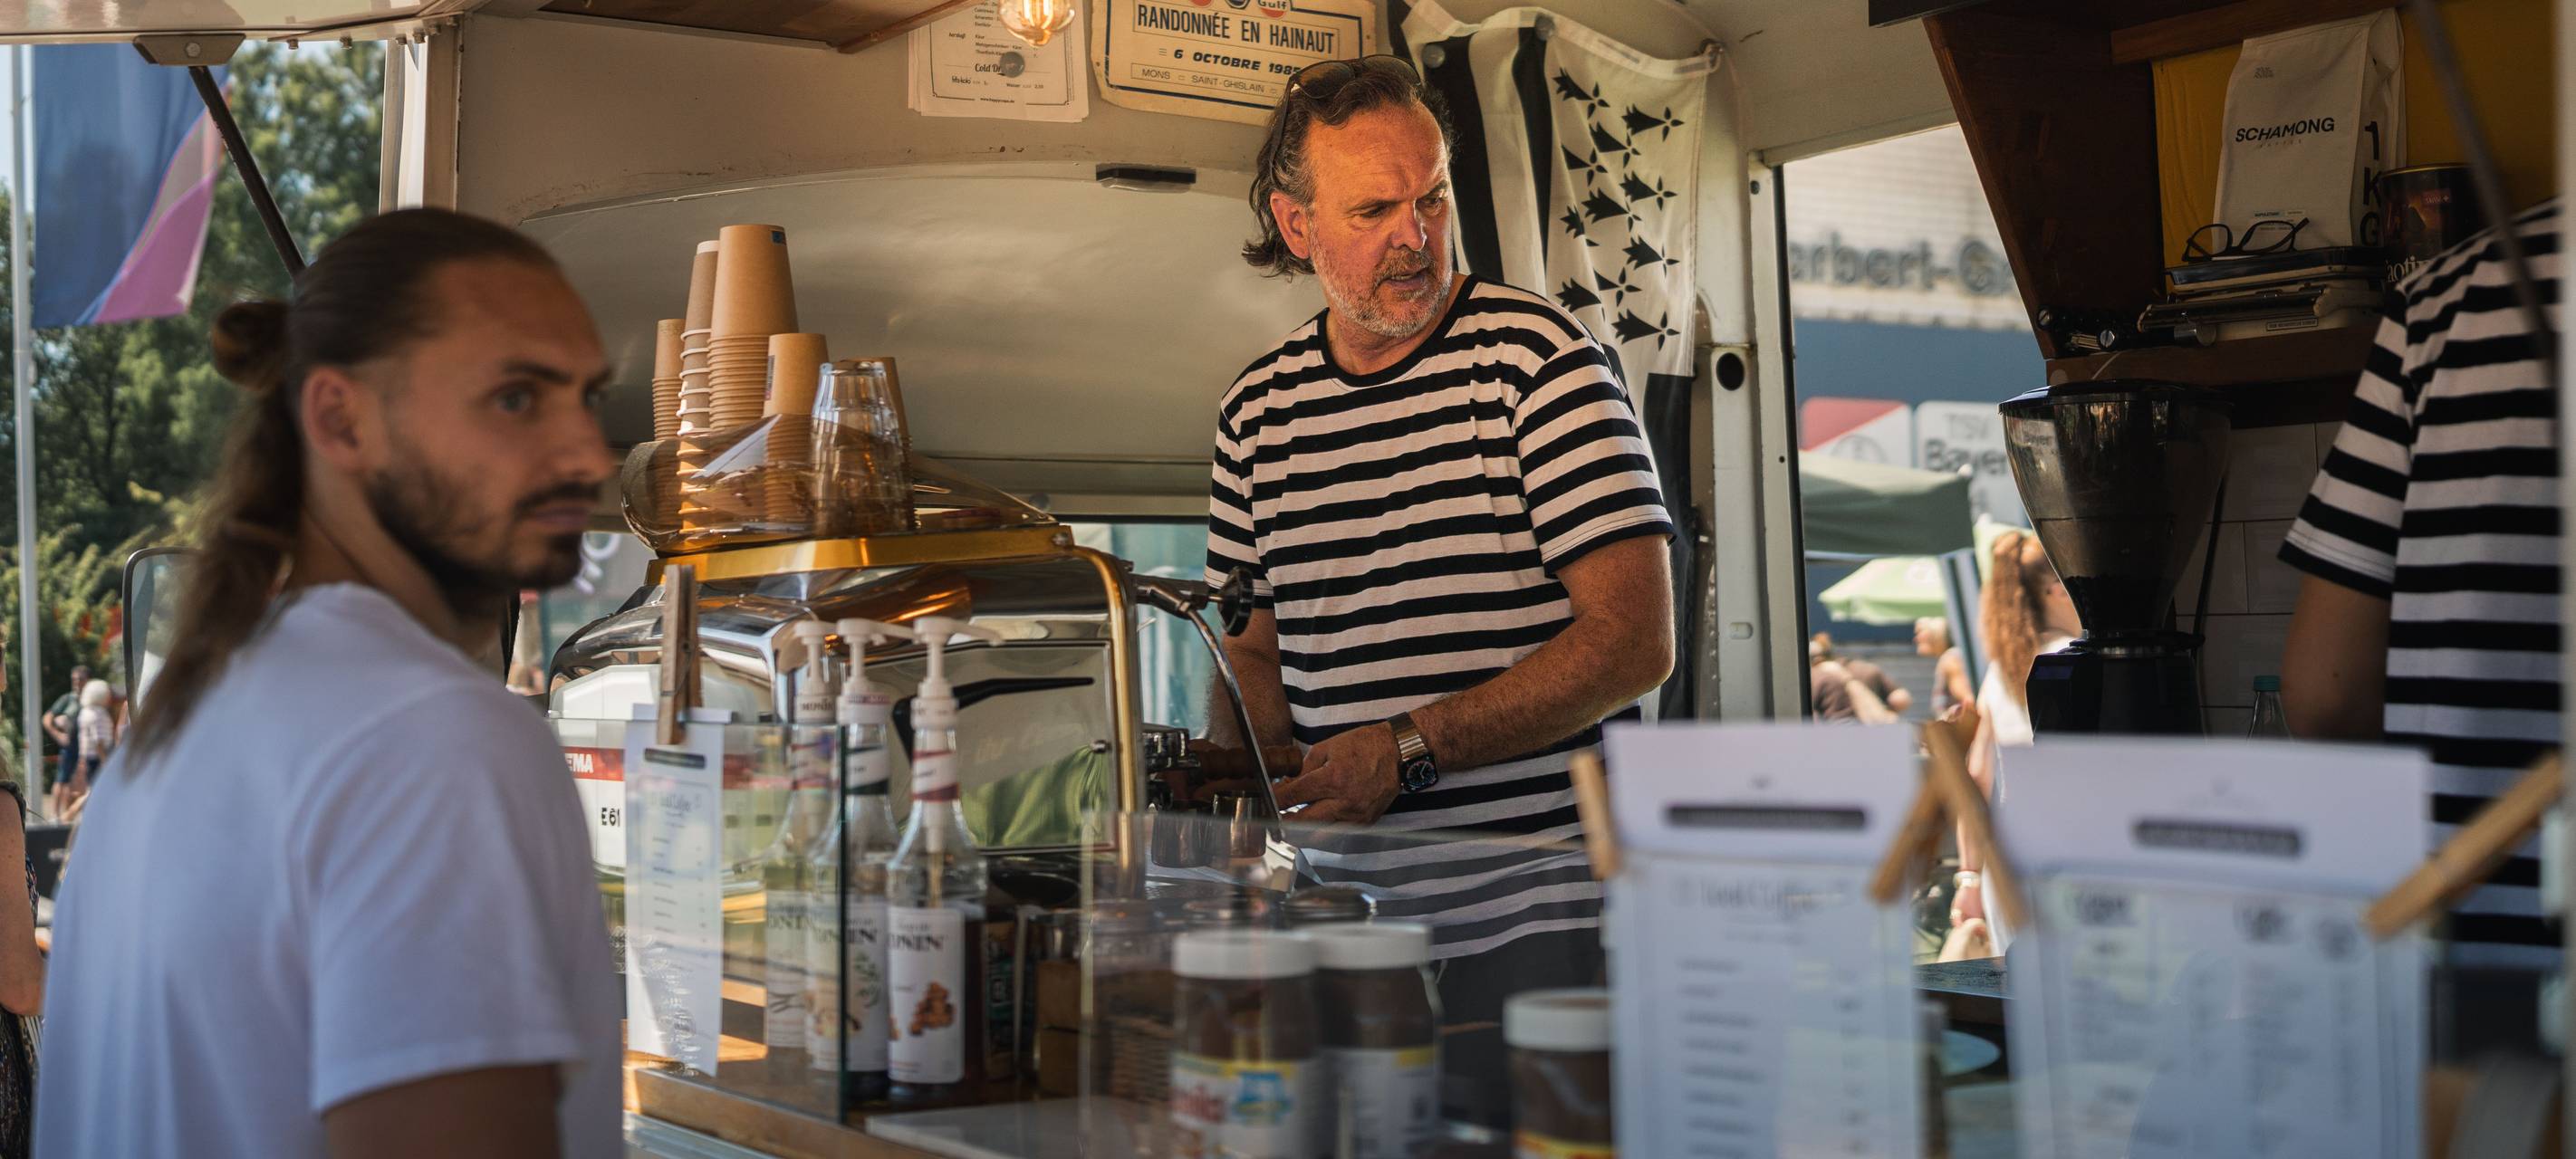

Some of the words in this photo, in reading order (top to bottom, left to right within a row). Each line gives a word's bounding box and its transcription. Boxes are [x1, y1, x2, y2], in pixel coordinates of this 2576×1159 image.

[1257, 0, 1286, 10] Gulf
[1138, 4, 1231, 39] RANDONNÉE
[1241, 20, 1260, 43] EN
[1269, 24, 1334, 54] HAINAUT
[975, 63, 991, 72] Cold
[1174, 49, 1184, 59] 6
[1193, 52, 1261, 71] OCTOBRE
[1142, 68, 1170, 80] MONS
[1191, 74, 1264, 92] SAINT-GHISLAIN
[2235, 117, 2335, 143] SCHAMONG
